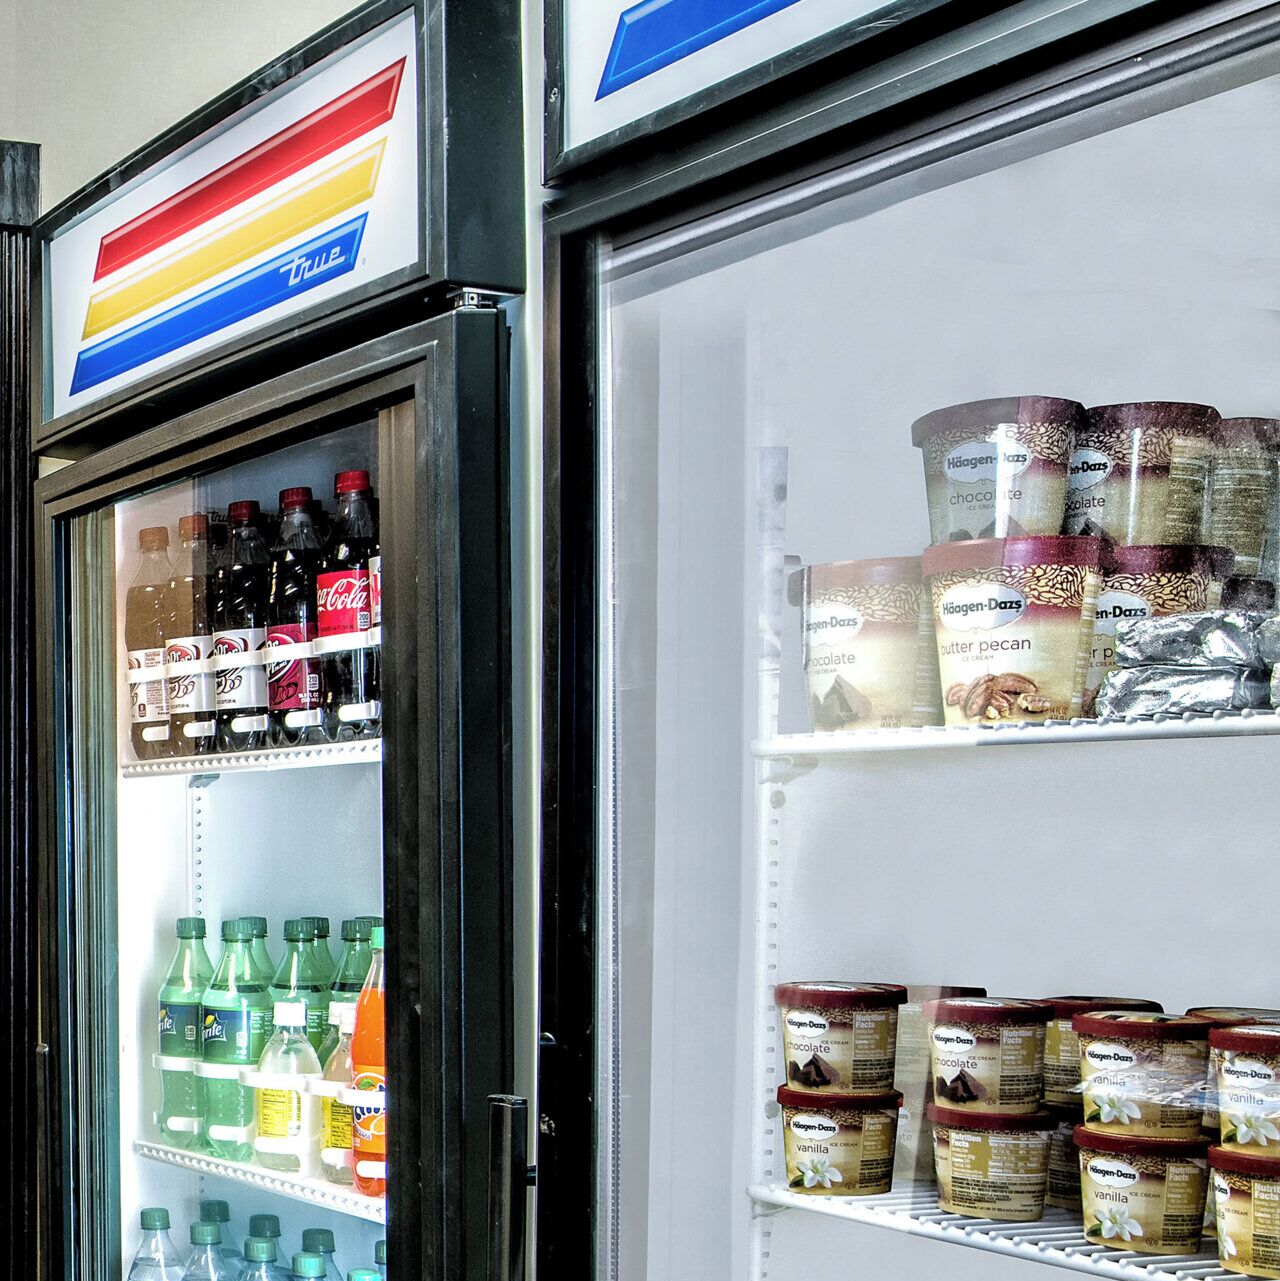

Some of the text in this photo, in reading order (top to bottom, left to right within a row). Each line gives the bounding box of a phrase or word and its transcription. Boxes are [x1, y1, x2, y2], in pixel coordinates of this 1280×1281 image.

[279, 246, 346, 287] true
[947, 452, 1028, 469] Häagen-azs
[206, 510, 228, 524] tru
[979, 639, 1032, 657] pecan
[972, 654, 994, 662] CREAM
[797, 1142, 829, 1154] vanilla
[1093, 1189, 1129, 1204] vanilla
